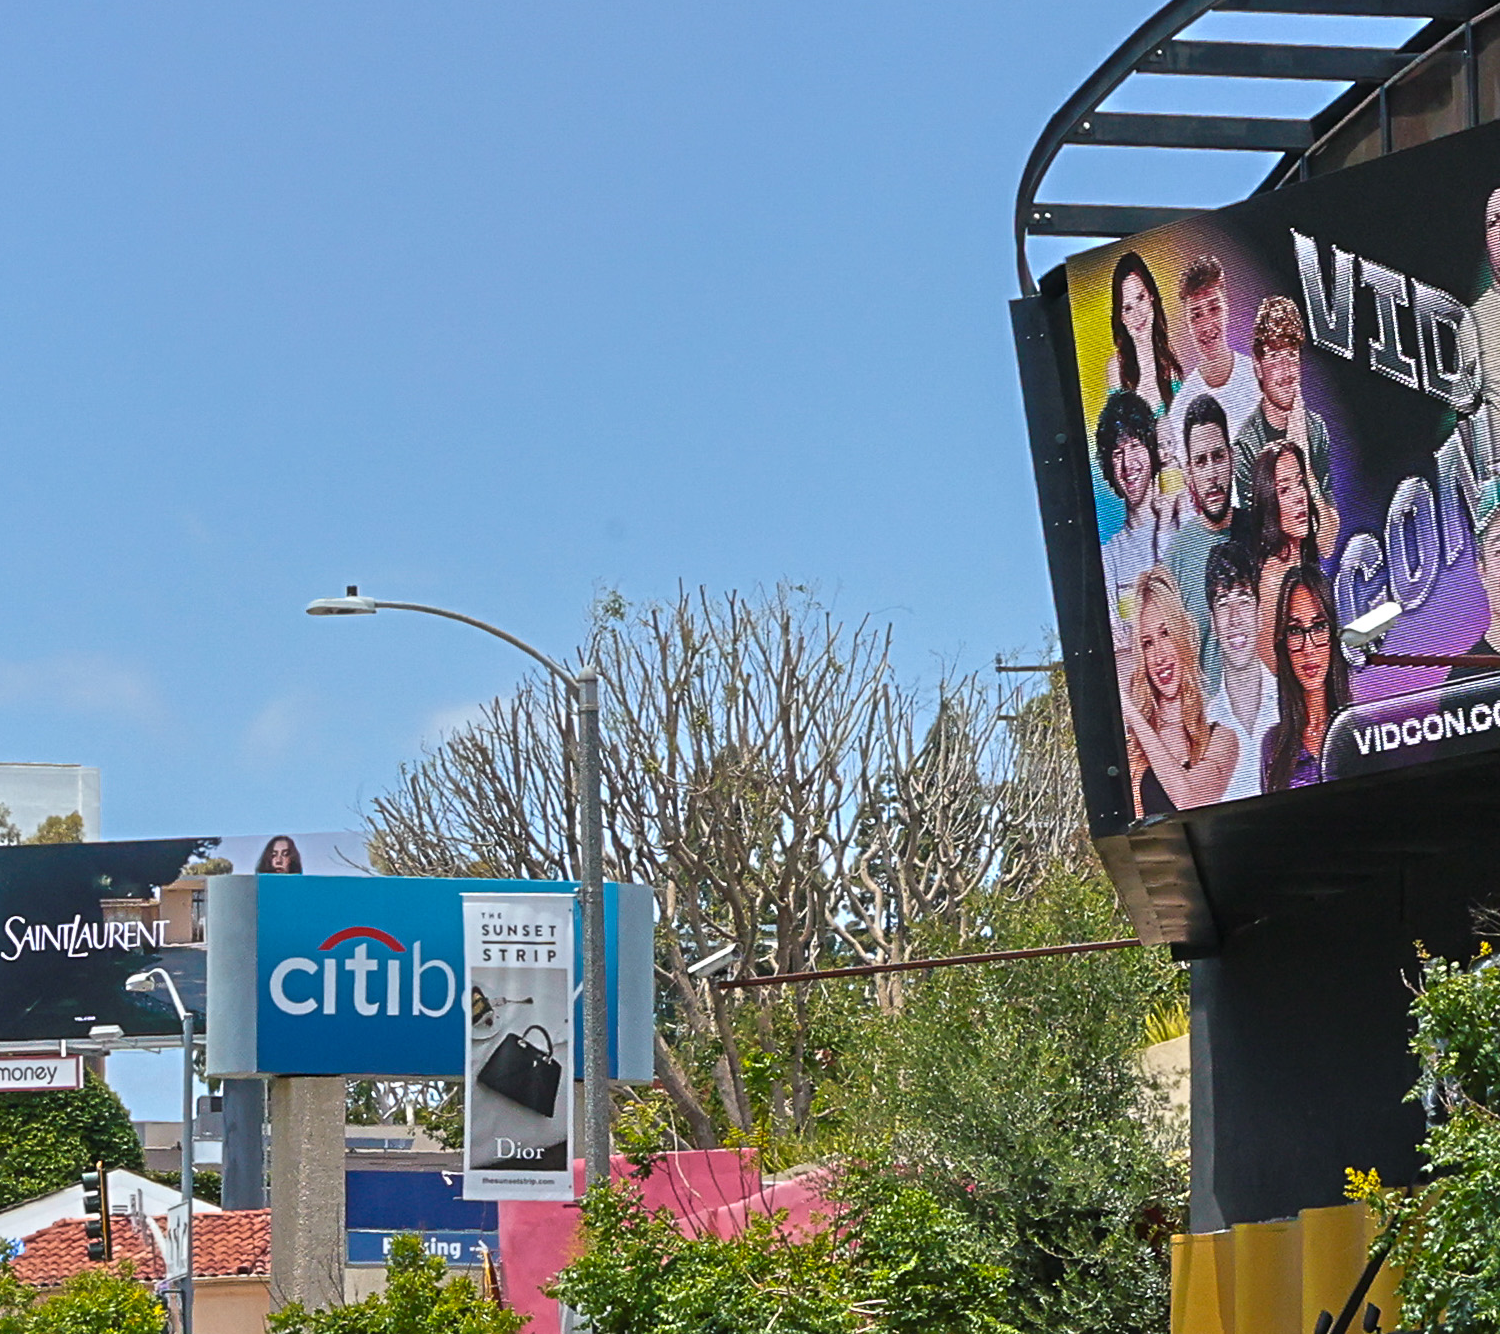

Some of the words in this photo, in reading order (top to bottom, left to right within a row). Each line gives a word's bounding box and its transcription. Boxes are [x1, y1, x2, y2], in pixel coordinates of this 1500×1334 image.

[1290, 227, 1482, 416] VID
[481, 911, 503, 920] THE
[481, 924, 557, 938] SUNSET
[482, 948, 557, 963] STRIP
[495, 1137, 545, 1160] Dior
